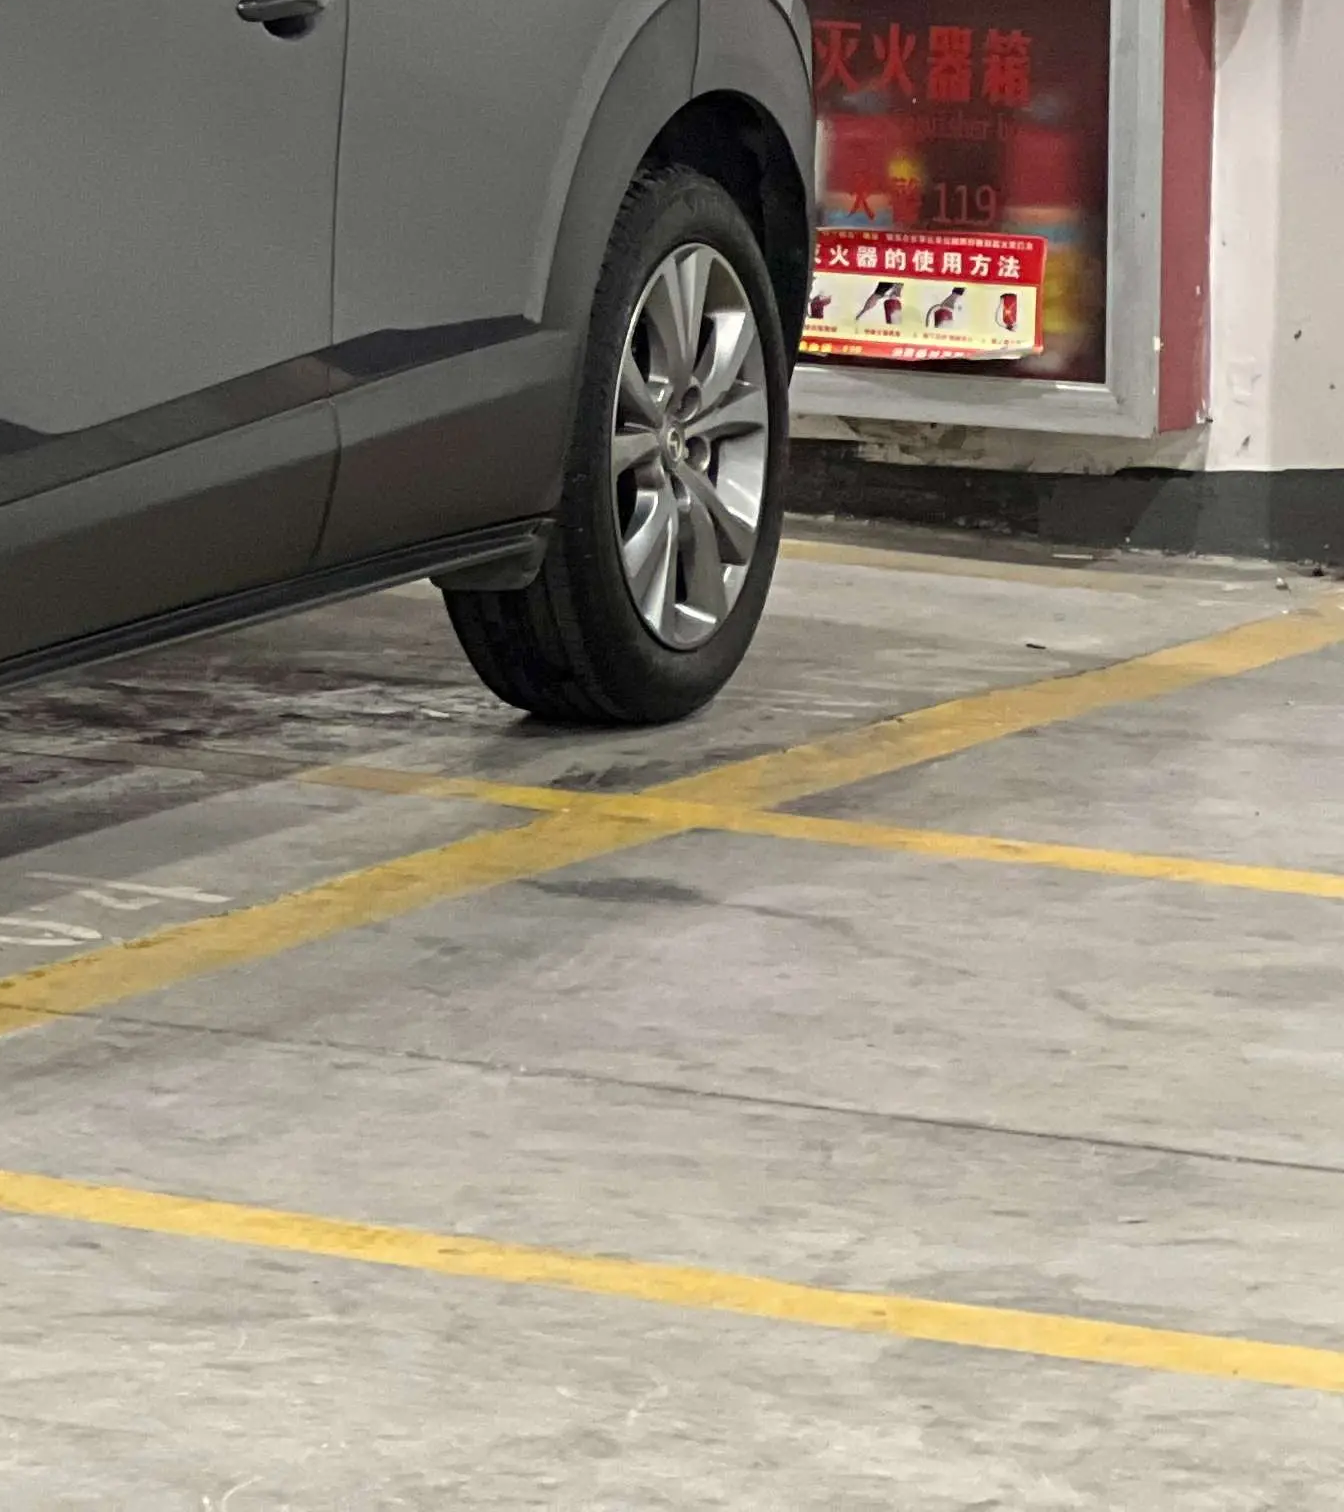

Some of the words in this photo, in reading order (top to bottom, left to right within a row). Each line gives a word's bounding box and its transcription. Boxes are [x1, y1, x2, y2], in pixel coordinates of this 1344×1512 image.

[813, 18, 1033, 106] 灭火器箱
[932, 181, 998, 226] 119
